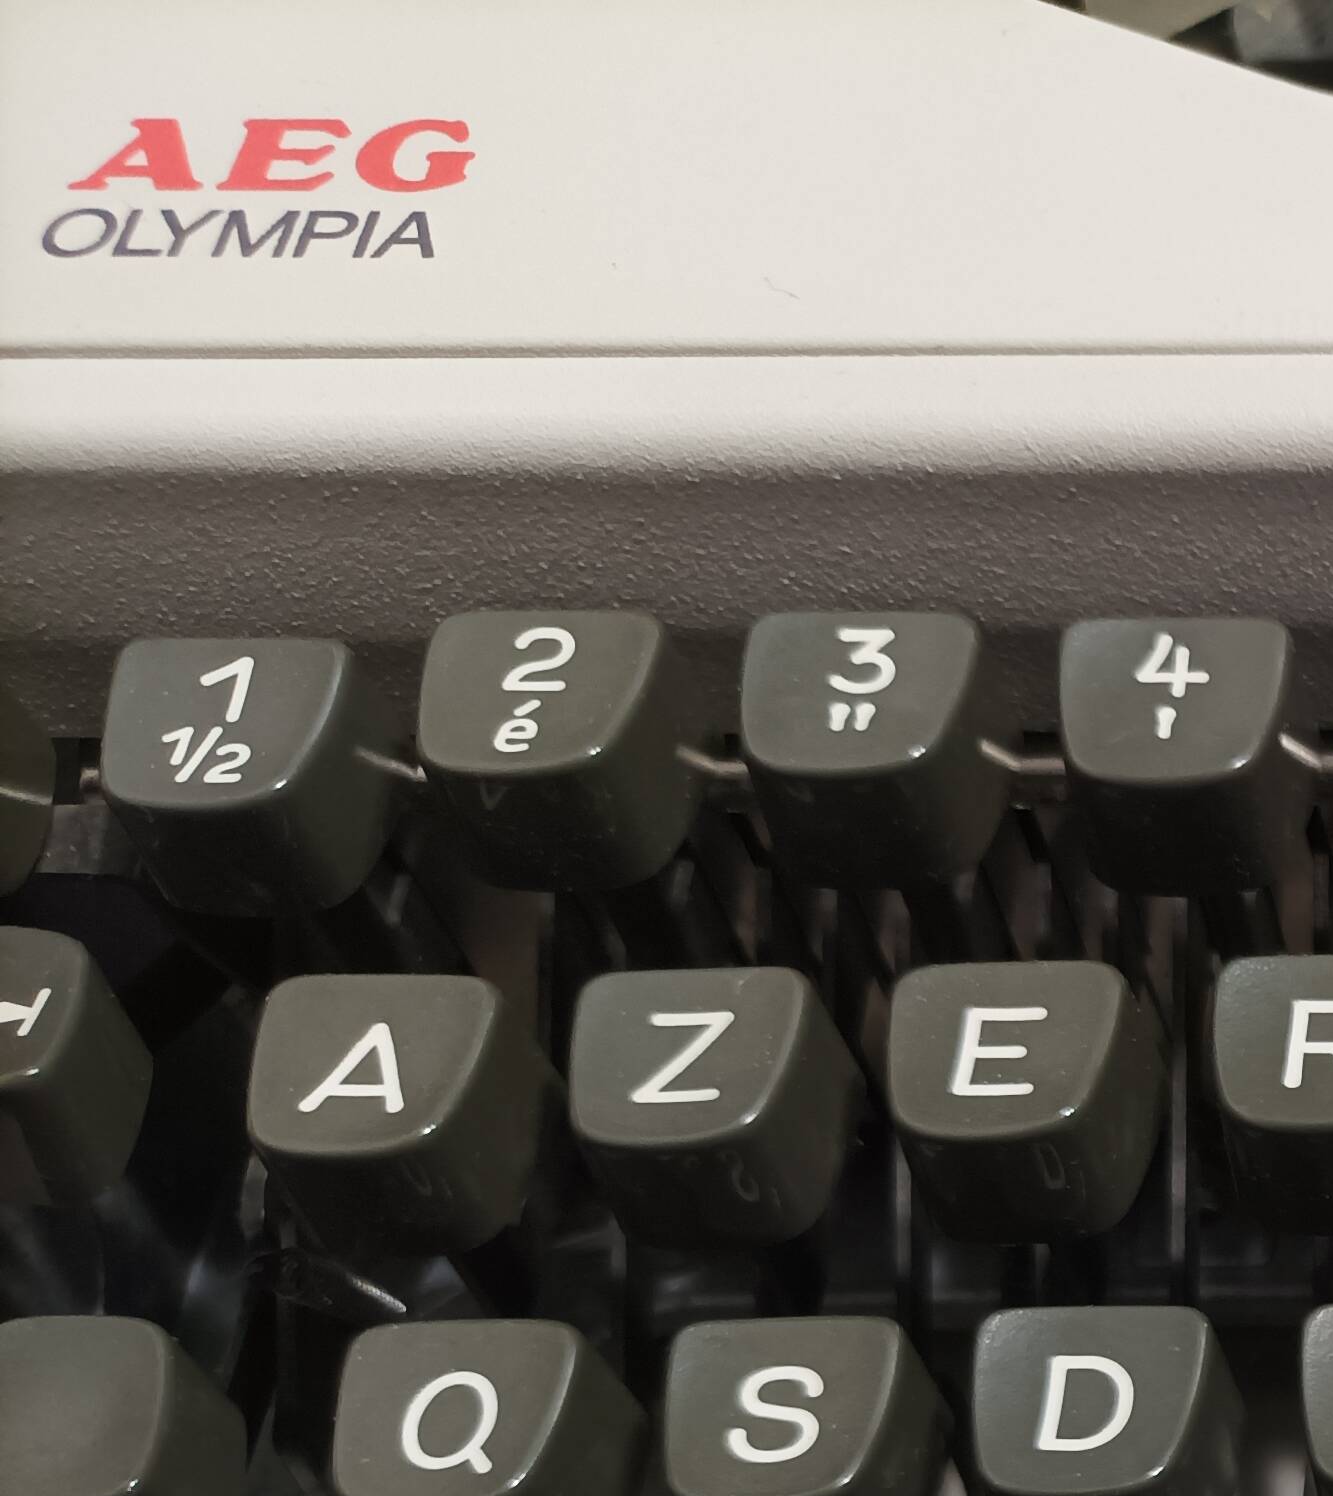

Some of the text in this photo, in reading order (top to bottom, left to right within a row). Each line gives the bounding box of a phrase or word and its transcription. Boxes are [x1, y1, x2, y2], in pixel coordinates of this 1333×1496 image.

[68, 117, 475, 192] AEG
[41, 208, 435, 258] OLYMPIA
[199, 656, 255, 723] 1
[501, 626, 576, 692] 2
[828, 627, 896, 694] 3
[1135, 633, 1210, 698] 4
[161, 725, 251, 784] 1/2
[297, 1022, 405, 1114] A
[630, 1011, 735, 1104] Z
[950, 1006, 1048, 1097] E
[401, 1371, 498, 1474] Q
[727, 1365, 824, 1463] S
[1036, 1355, 1134, 1452] D
